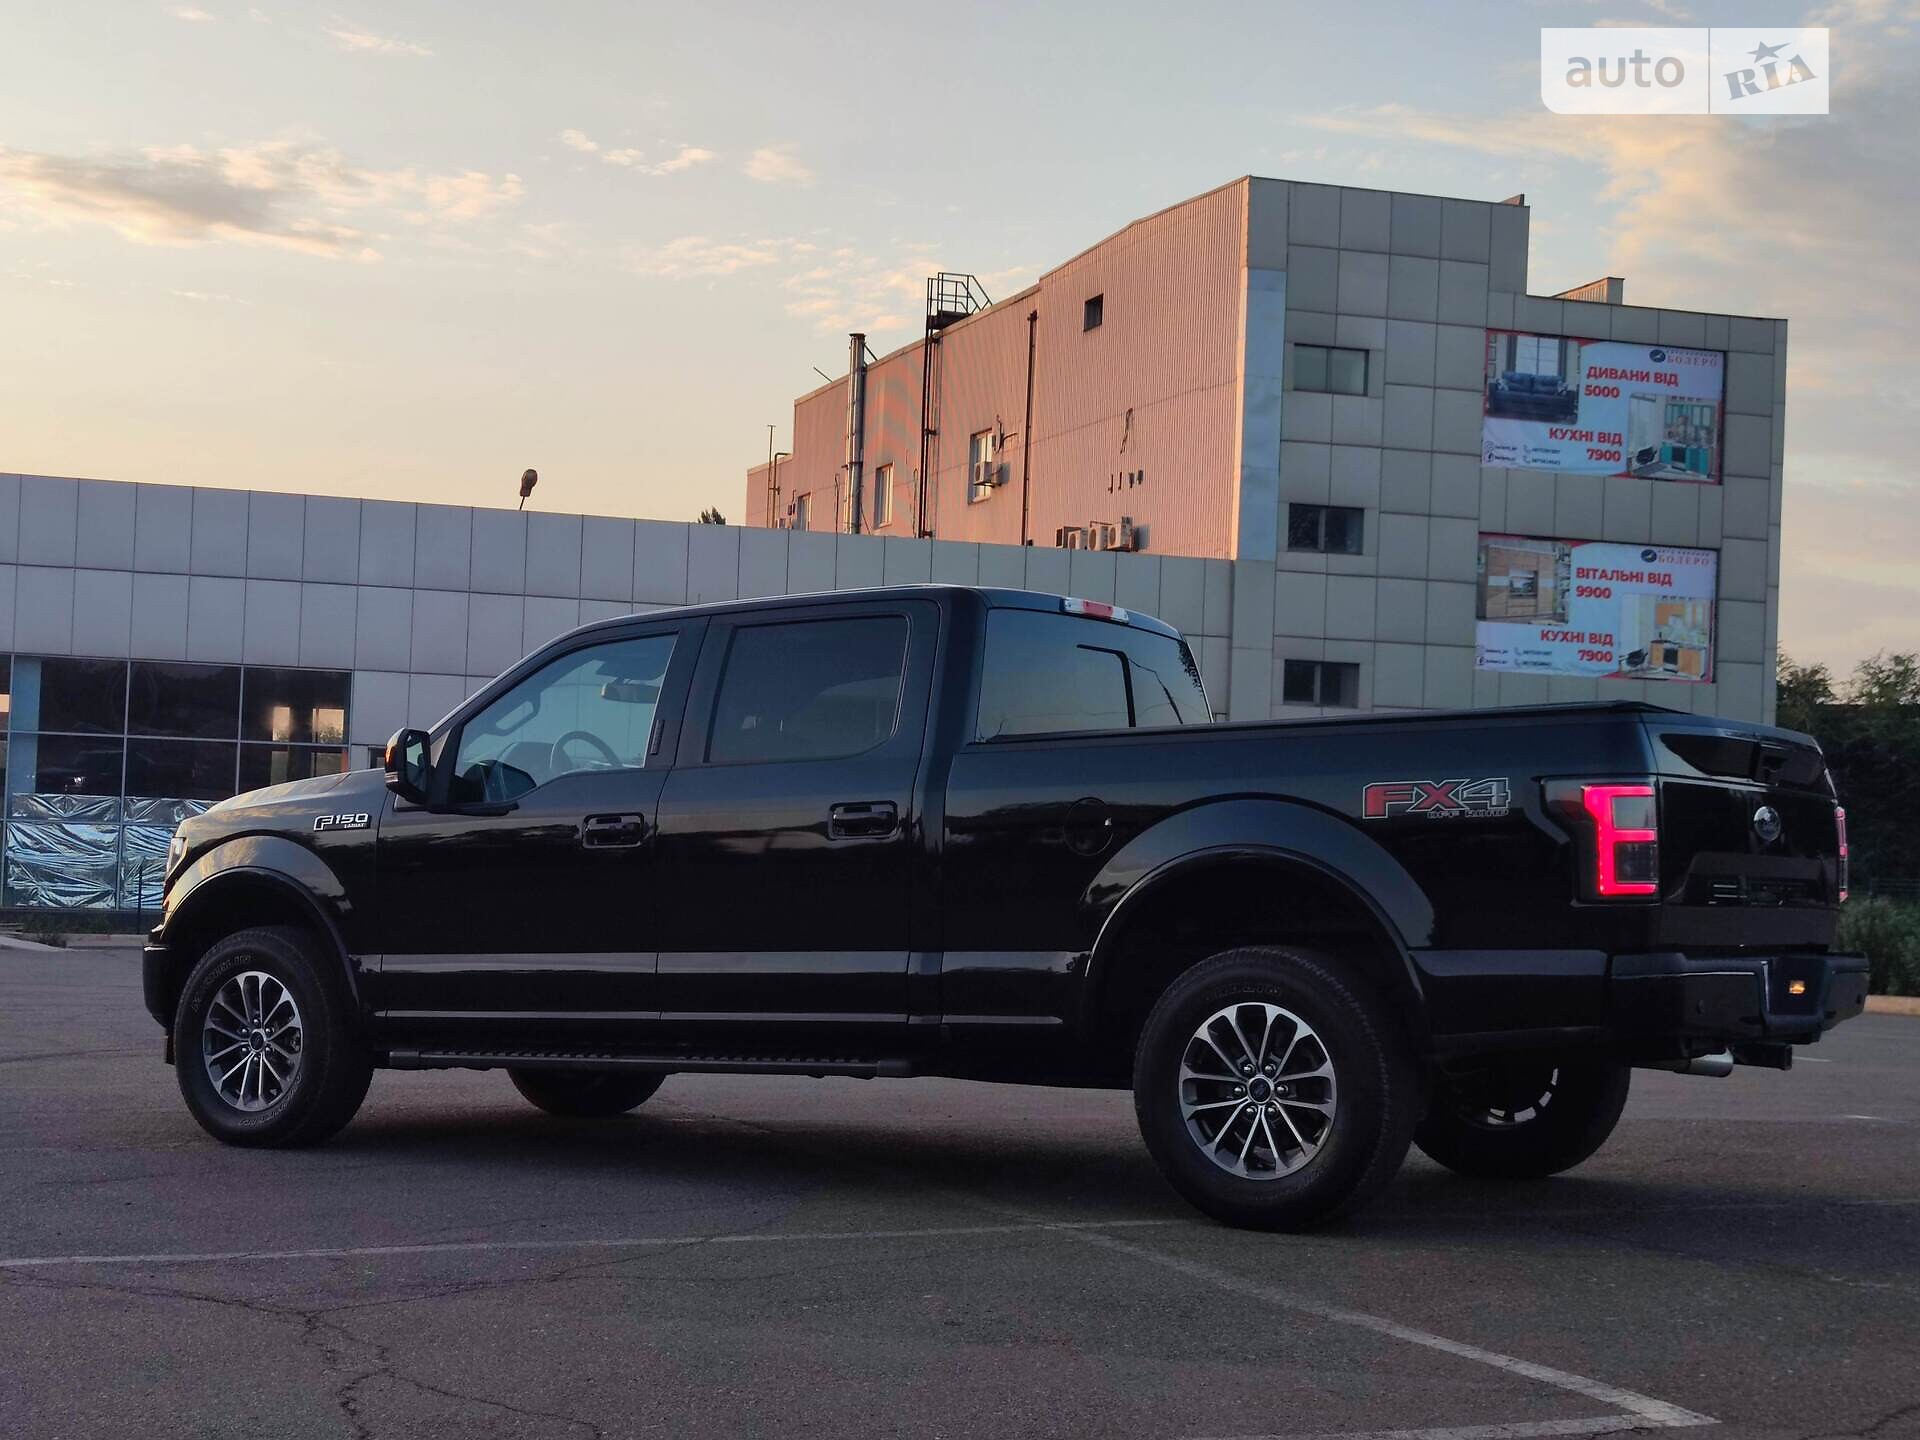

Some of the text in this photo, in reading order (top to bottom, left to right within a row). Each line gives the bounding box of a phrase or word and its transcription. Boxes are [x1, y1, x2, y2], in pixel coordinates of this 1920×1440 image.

[1586, 366, 1679, 387] ДИВАНИ ВІД
[1584, 384, 1620, 399] 5000
[1549, 426, 1593, 443] КУХНІ
[1586, 448, 1621, 462] 7900
[1576, 567, 1672, 587] ВІТАЛЬНІ ВІД
[1576, 585, 1612, 599] 9900
[1540, 629, 1585, 644] КУХНІ
[1577, 649, 1612, 663] 7900
[1362, 777, 1511, 820] FX4
